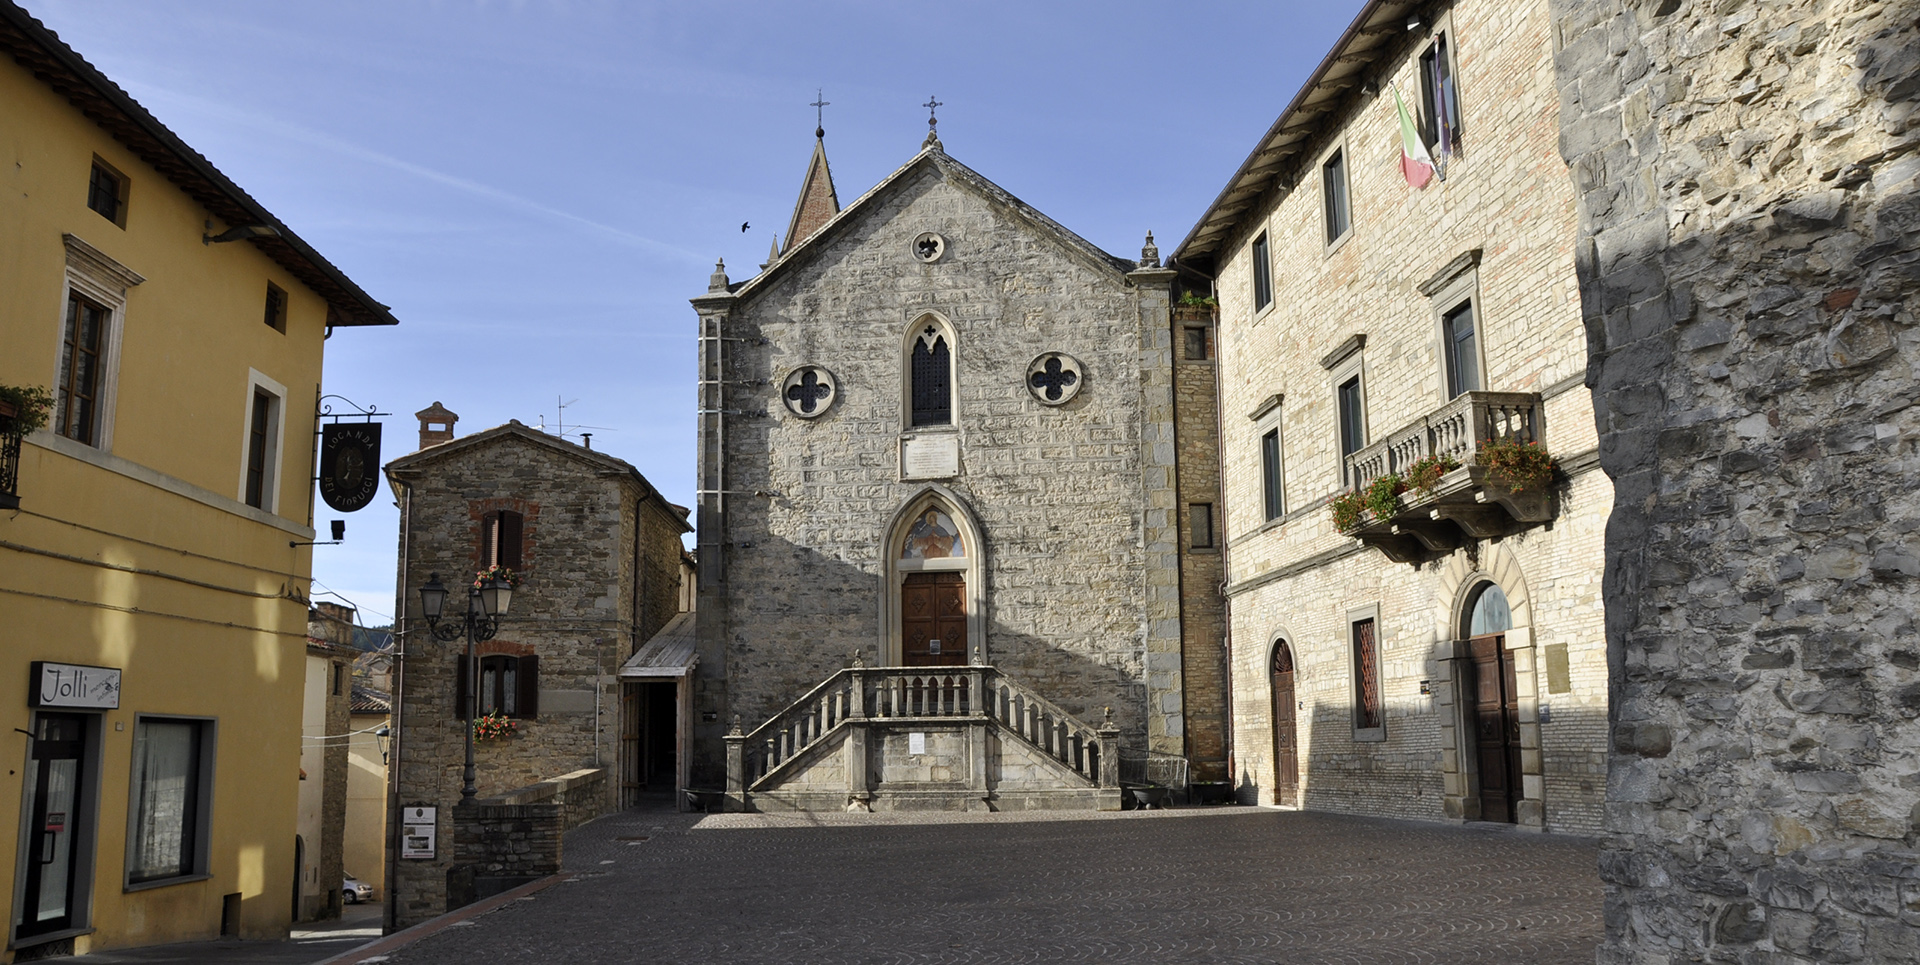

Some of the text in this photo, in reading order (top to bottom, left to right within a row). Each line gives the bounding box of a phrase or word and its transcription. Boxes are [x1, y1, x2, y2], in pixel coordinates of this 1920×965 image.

[328, 430, 374, 450] LOCANDA
[325, 477, 373, 506] DEI FIORUCCI
[42, 669, 87, 703] Jolli
